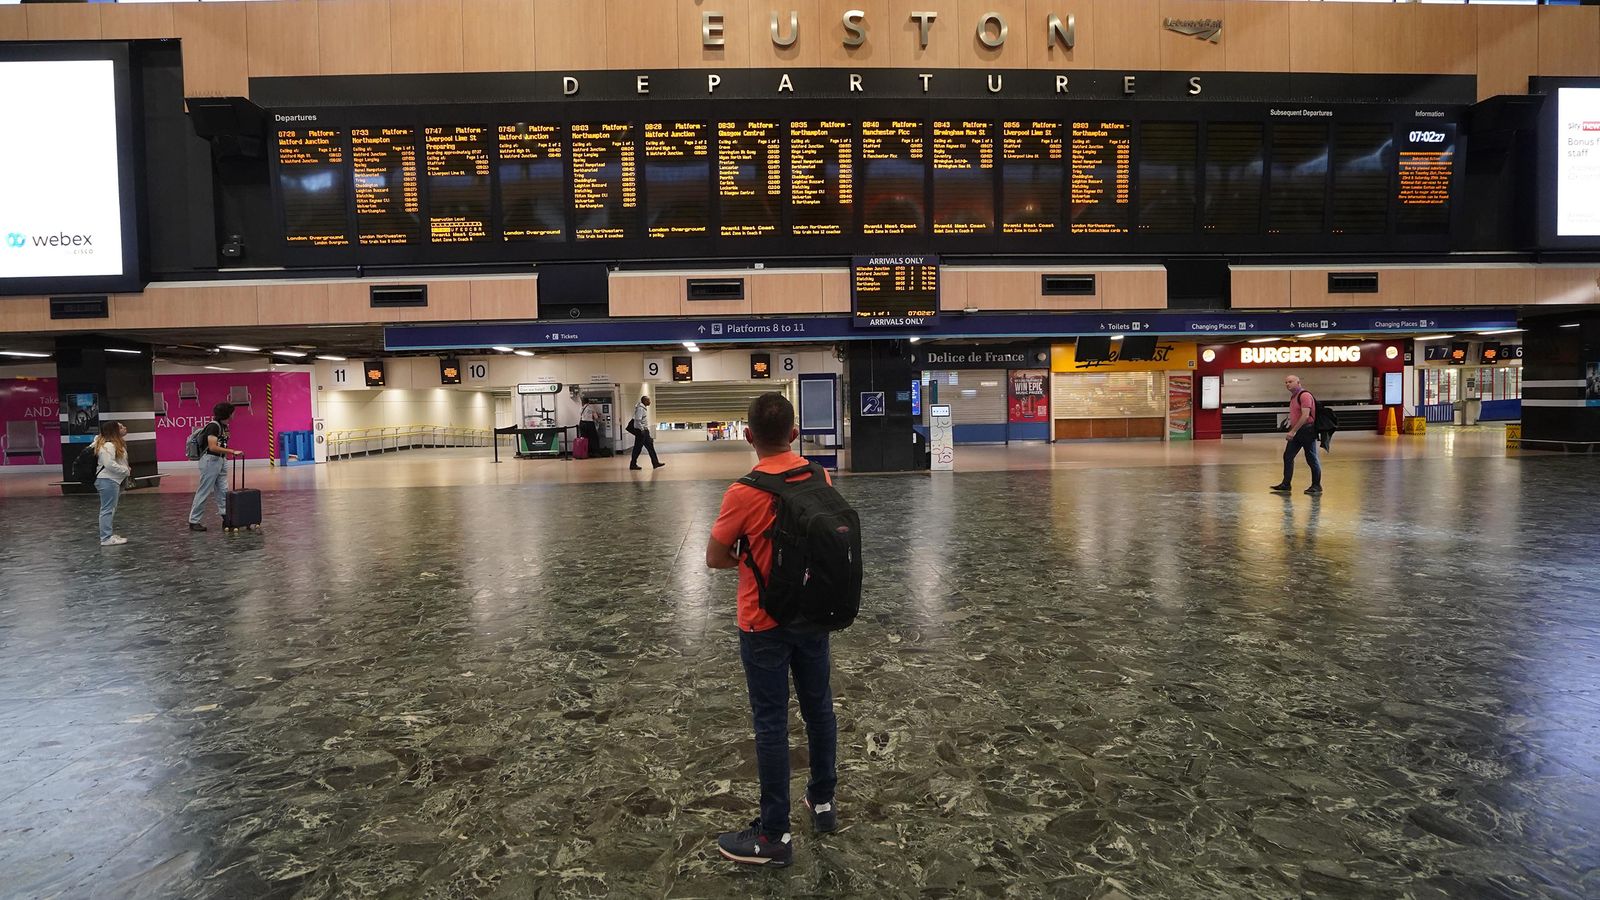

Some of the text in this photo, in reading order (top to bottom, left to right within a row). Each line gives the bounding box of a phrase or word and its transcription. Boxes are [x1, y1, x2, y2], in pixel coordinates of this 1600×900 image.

[702, 10, 1075, 49] EUSTON
[563, 74, 1202, 96] DEPARTURES
[1568, 138, 1594, 146] Bonus
[32, 232, 92, 246] webex
[727, 324, 770, 333] Platforms
[772, 324, 778, 332] 8
[794, 324, 805, 332] 11
[928, 352, 1024, 362] Delice de France
[1240, 346, 1360, 363] BURGER KING
[1428, 348, 1435, 358] 7
[1442, 348, 1448, 357] 7
[1502, 348, 1508, 357] 6
[1516, 347, 1523, 357] 6
[648, 362, 658, 376] 9
[784, 358, 794, 371] 8
[334, 369, 346, 382] 11
[470, 365, 486, 378] 10
[1015, 382, 1043, 391] WIN EPIC
[40, 396, 58, 404] Take
[24, 407, 52, 418] AND
[158, 416, 215, 428] ANOTHE
